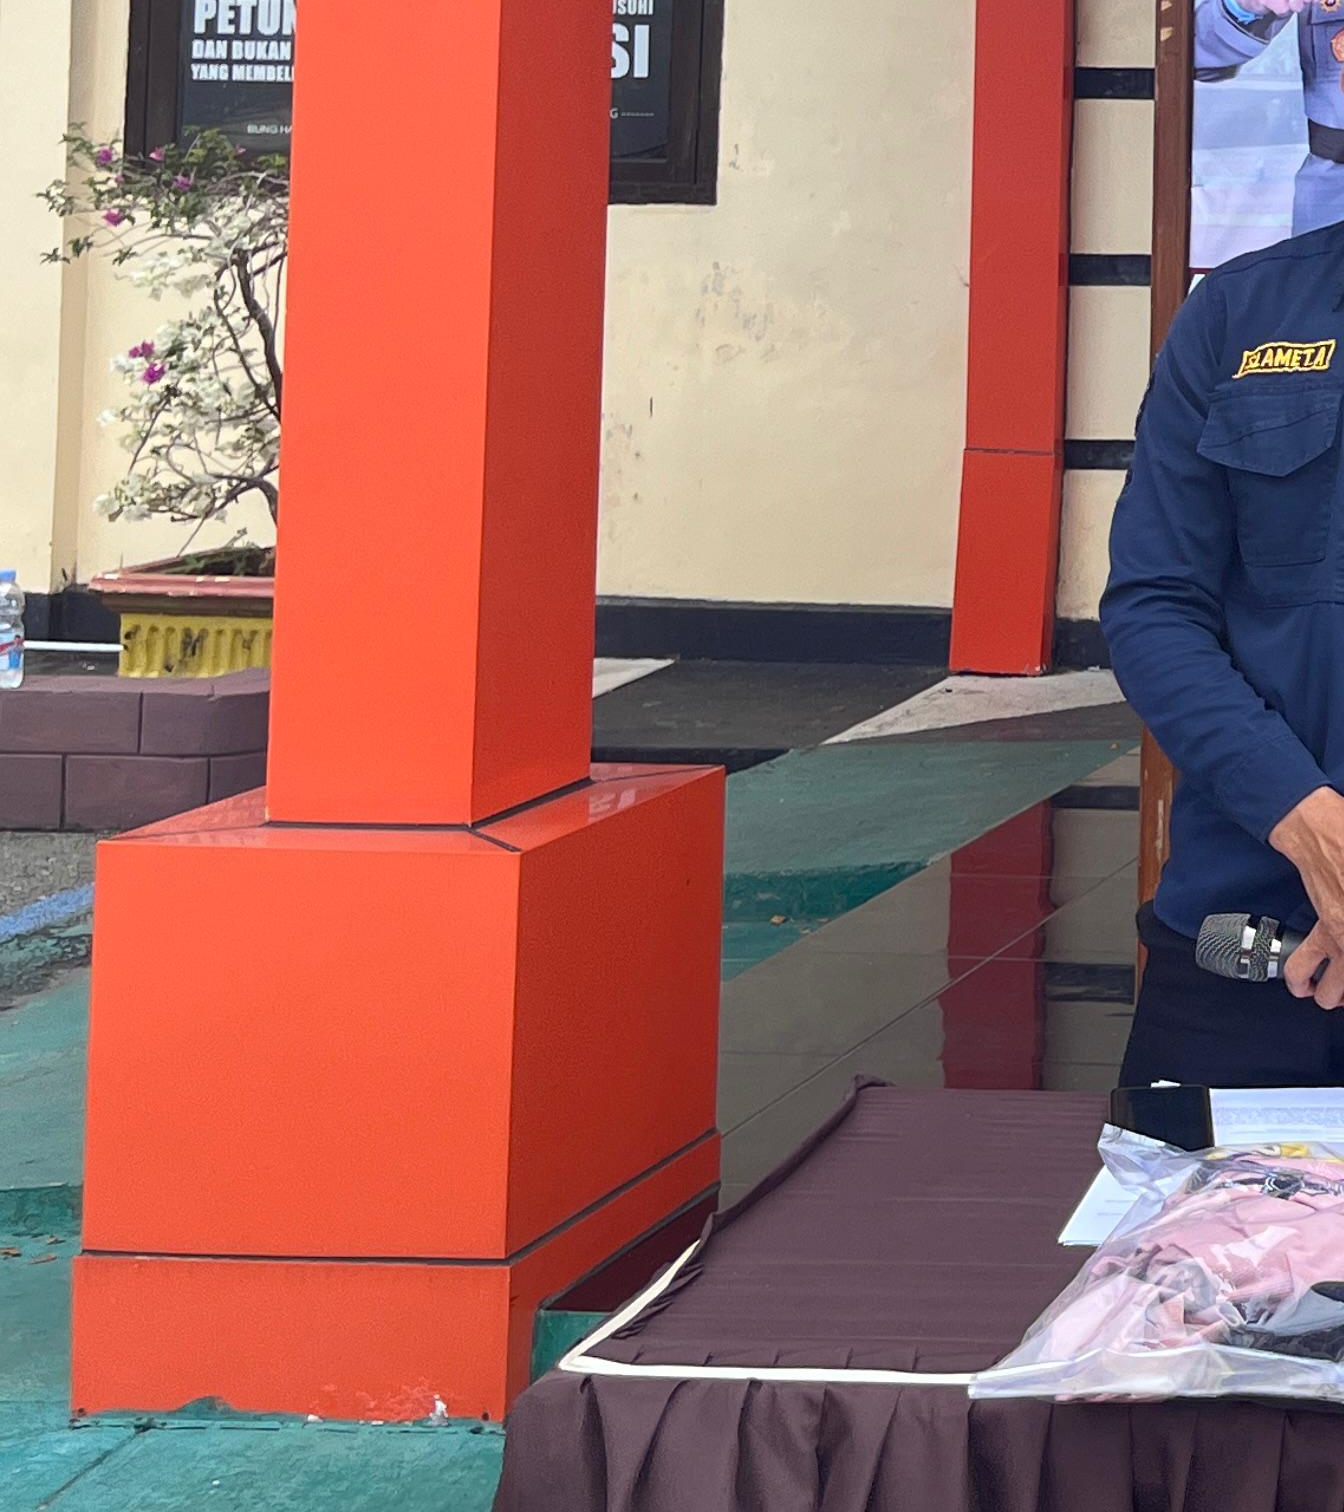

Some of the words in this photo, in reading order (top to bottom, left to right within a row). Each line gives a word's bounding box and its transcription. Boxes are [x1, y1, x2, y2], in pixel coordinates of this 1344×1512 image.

[191, 39, 228, 60] DAN
[231, 40, 292, 61] BUKAN
[190, 63, 229, 81] YANG
